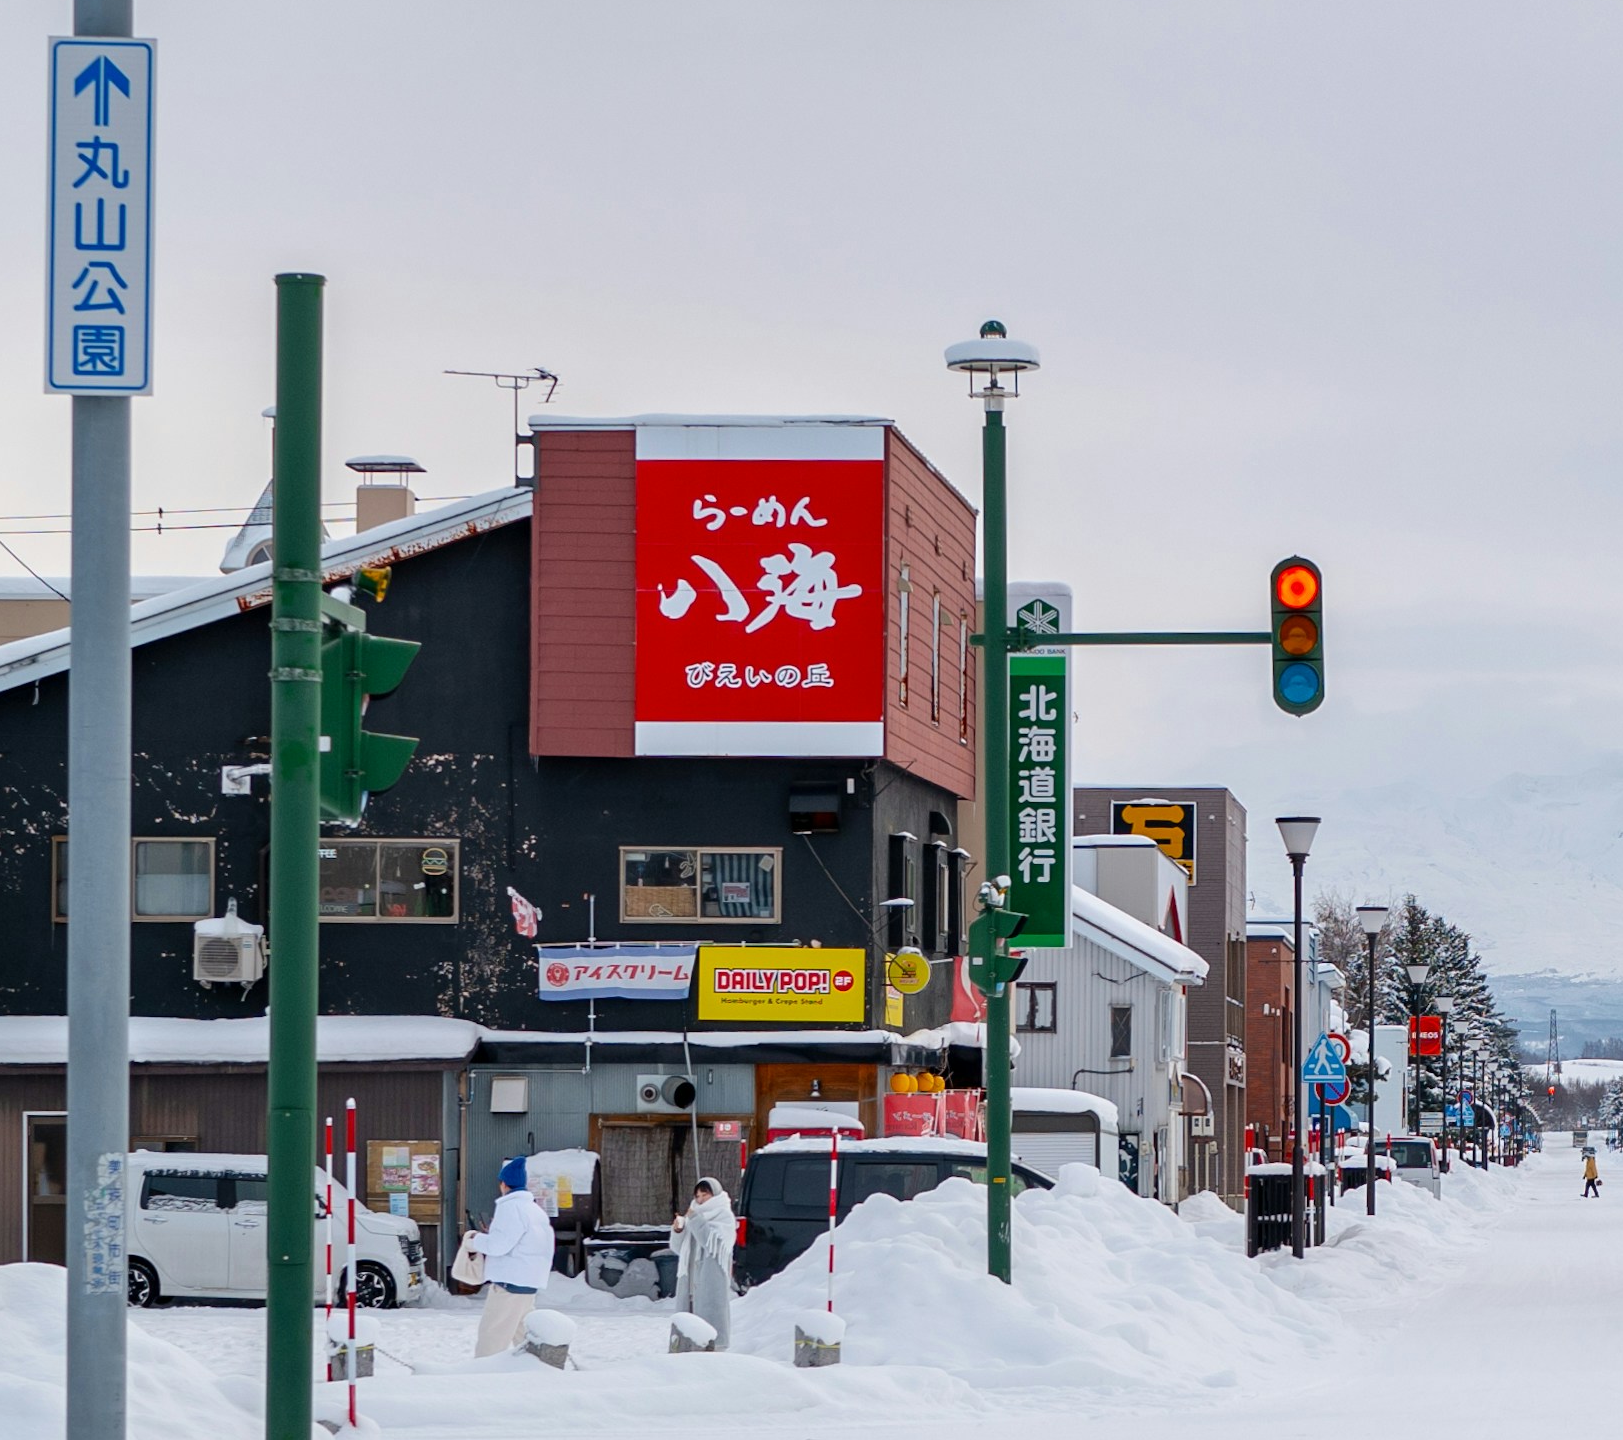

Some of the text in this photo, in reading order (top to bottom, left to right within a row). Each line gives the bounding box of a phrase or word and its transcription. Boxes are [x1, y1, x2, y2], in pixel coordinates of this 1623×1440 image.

[71, 136, 131, 377] 丸山公園
[692, 494, 828, 531] らーめん
[657, 543, 863, 634] 八海
[686, 661, 834, 688] びえいの丘
[1018, 684, 1057, 884] 北海道銀行
[573, 963, 690, 981] アイスクリーム
[715, 970, 774, 992] DAILY
[778, 970, 830, 993] POP!
[720, 997, 765, 1006] Hamburger
[775, 998, 798, 1006] Crepe
